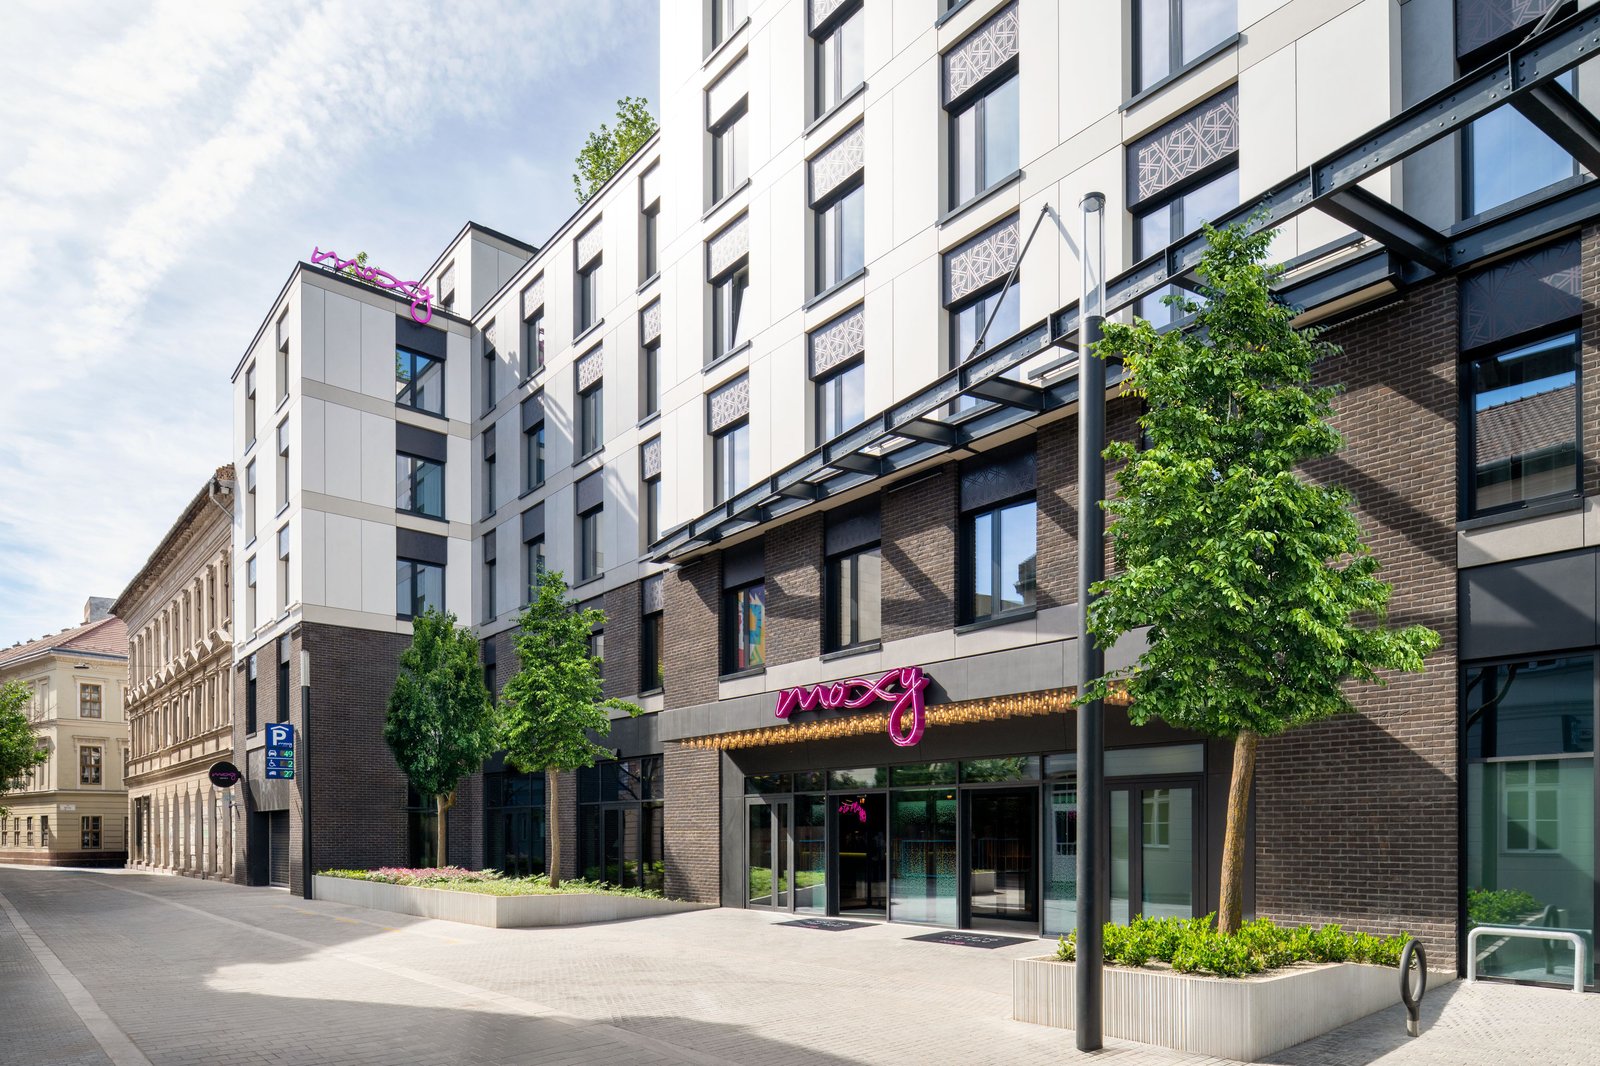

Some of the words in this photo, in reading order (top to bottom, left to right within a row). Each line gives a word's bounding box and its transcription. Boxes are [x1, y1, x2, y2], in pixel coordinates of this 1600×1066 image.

[311, 246, 434, 324] moxy
[272, 730, 286, 746] P
[775, 665, 930, 747] moxy
